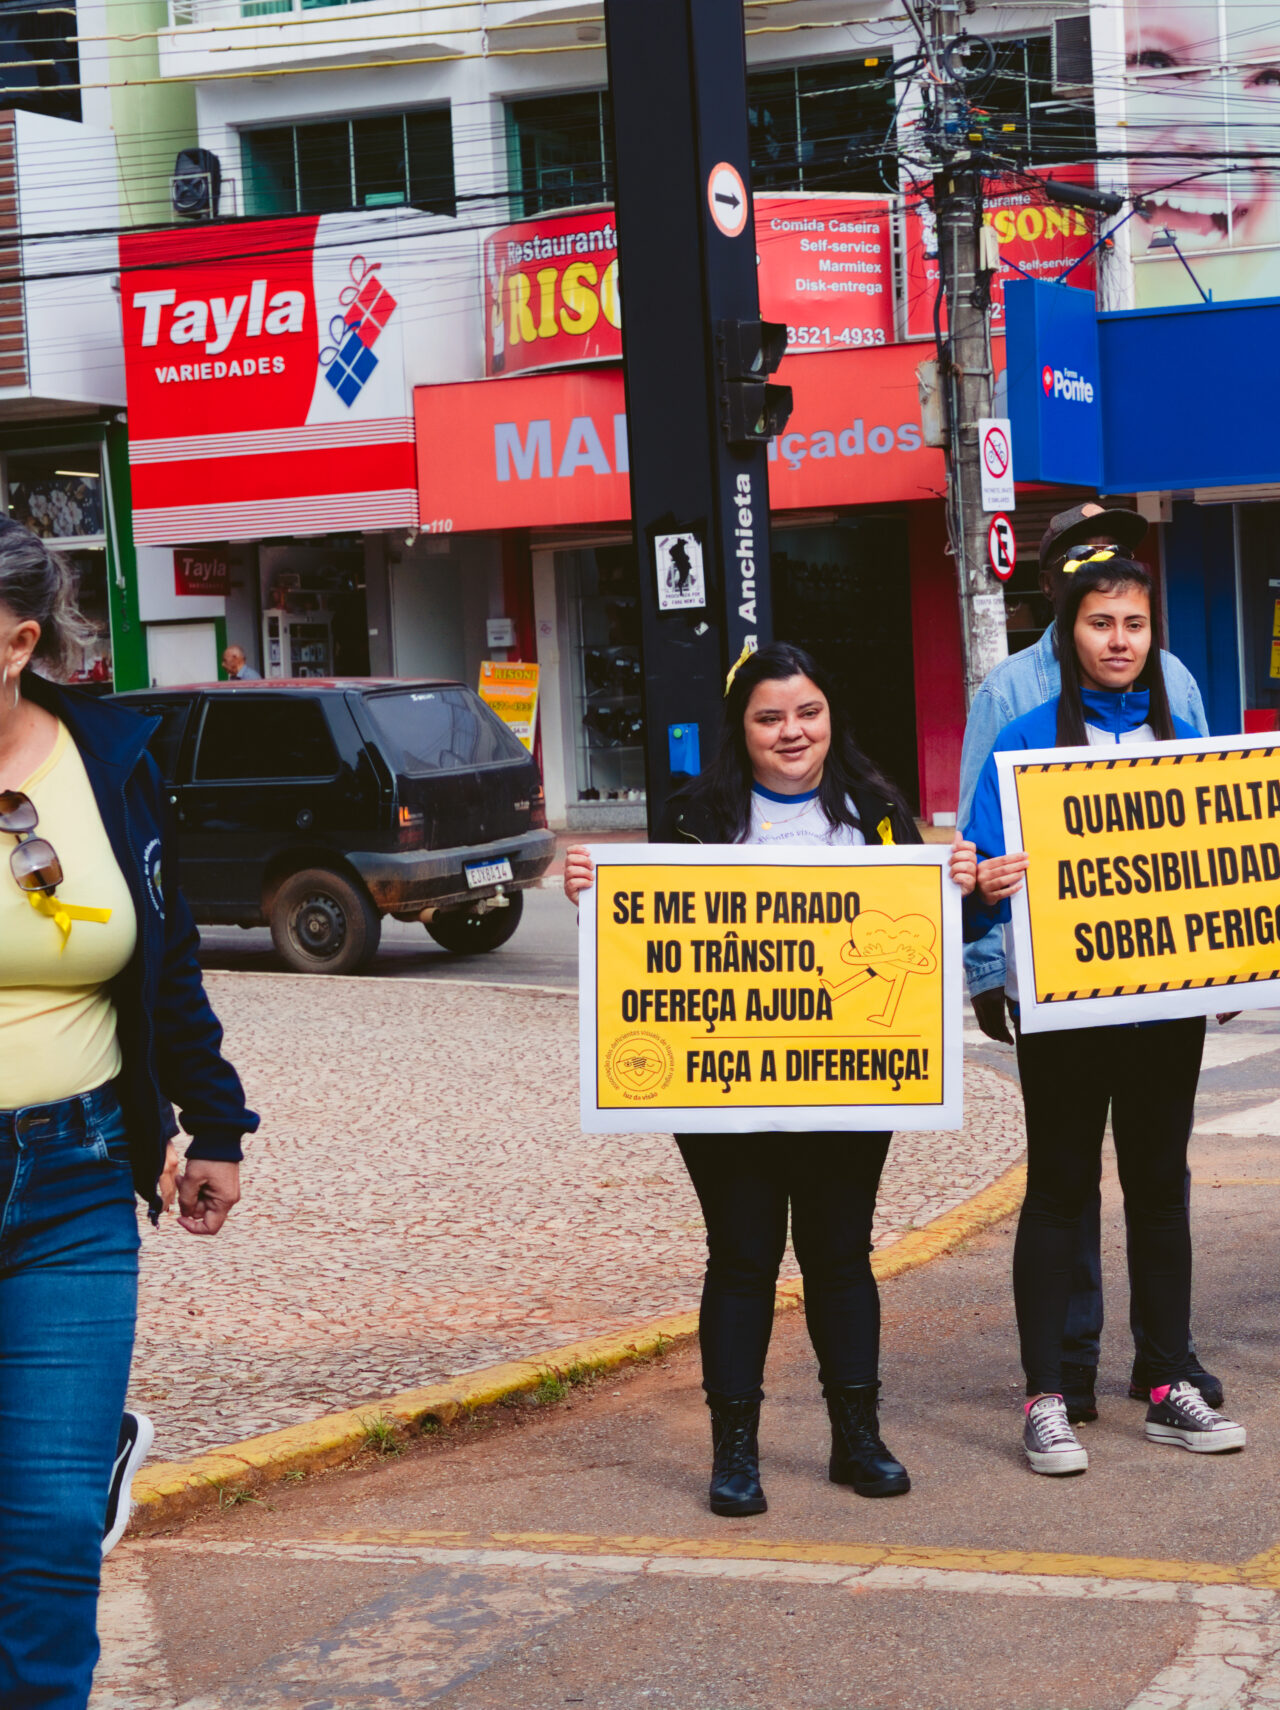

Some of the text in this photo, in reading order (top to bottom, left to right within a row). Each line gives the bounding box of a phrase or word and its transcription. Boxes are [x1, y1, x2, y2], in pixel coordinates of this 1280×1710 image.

[982, 193, 1032, 209] aurante
[770, 218, 880, 234] Comida Caseira
[507, 223, 618, 267] Restaurant
[800, 239, 881, 253] Self-service
[819, 259, 882, 273] Marmitex
[795, 278, 883, 296] Disk-entrega
[132, 279, 306, 355] Tayla
[786, 326, 886, 345] 3521-4933
[155, 356, 286, 384] VARIEDADES
[1054, 370, 1094, 403] Ponte
[430, 519, 453, 533] 110
[733, 473, 757, 624] Anchieta
[182, 558, 227, 581] Tayla
[1063, 788, 1186, 838] QUANDO
[613, 891, 861, 924] SE ME VIR PARADO
[646, 931, 824, 976] NO TRÂNSITO,
[1074, 916, 1177, 963] SOBRA
[621, 987, 834, 1033] OFEREÇA AJUDA
[686, 1048, 929, 1094] FAÇA A DIFERENÇA!
